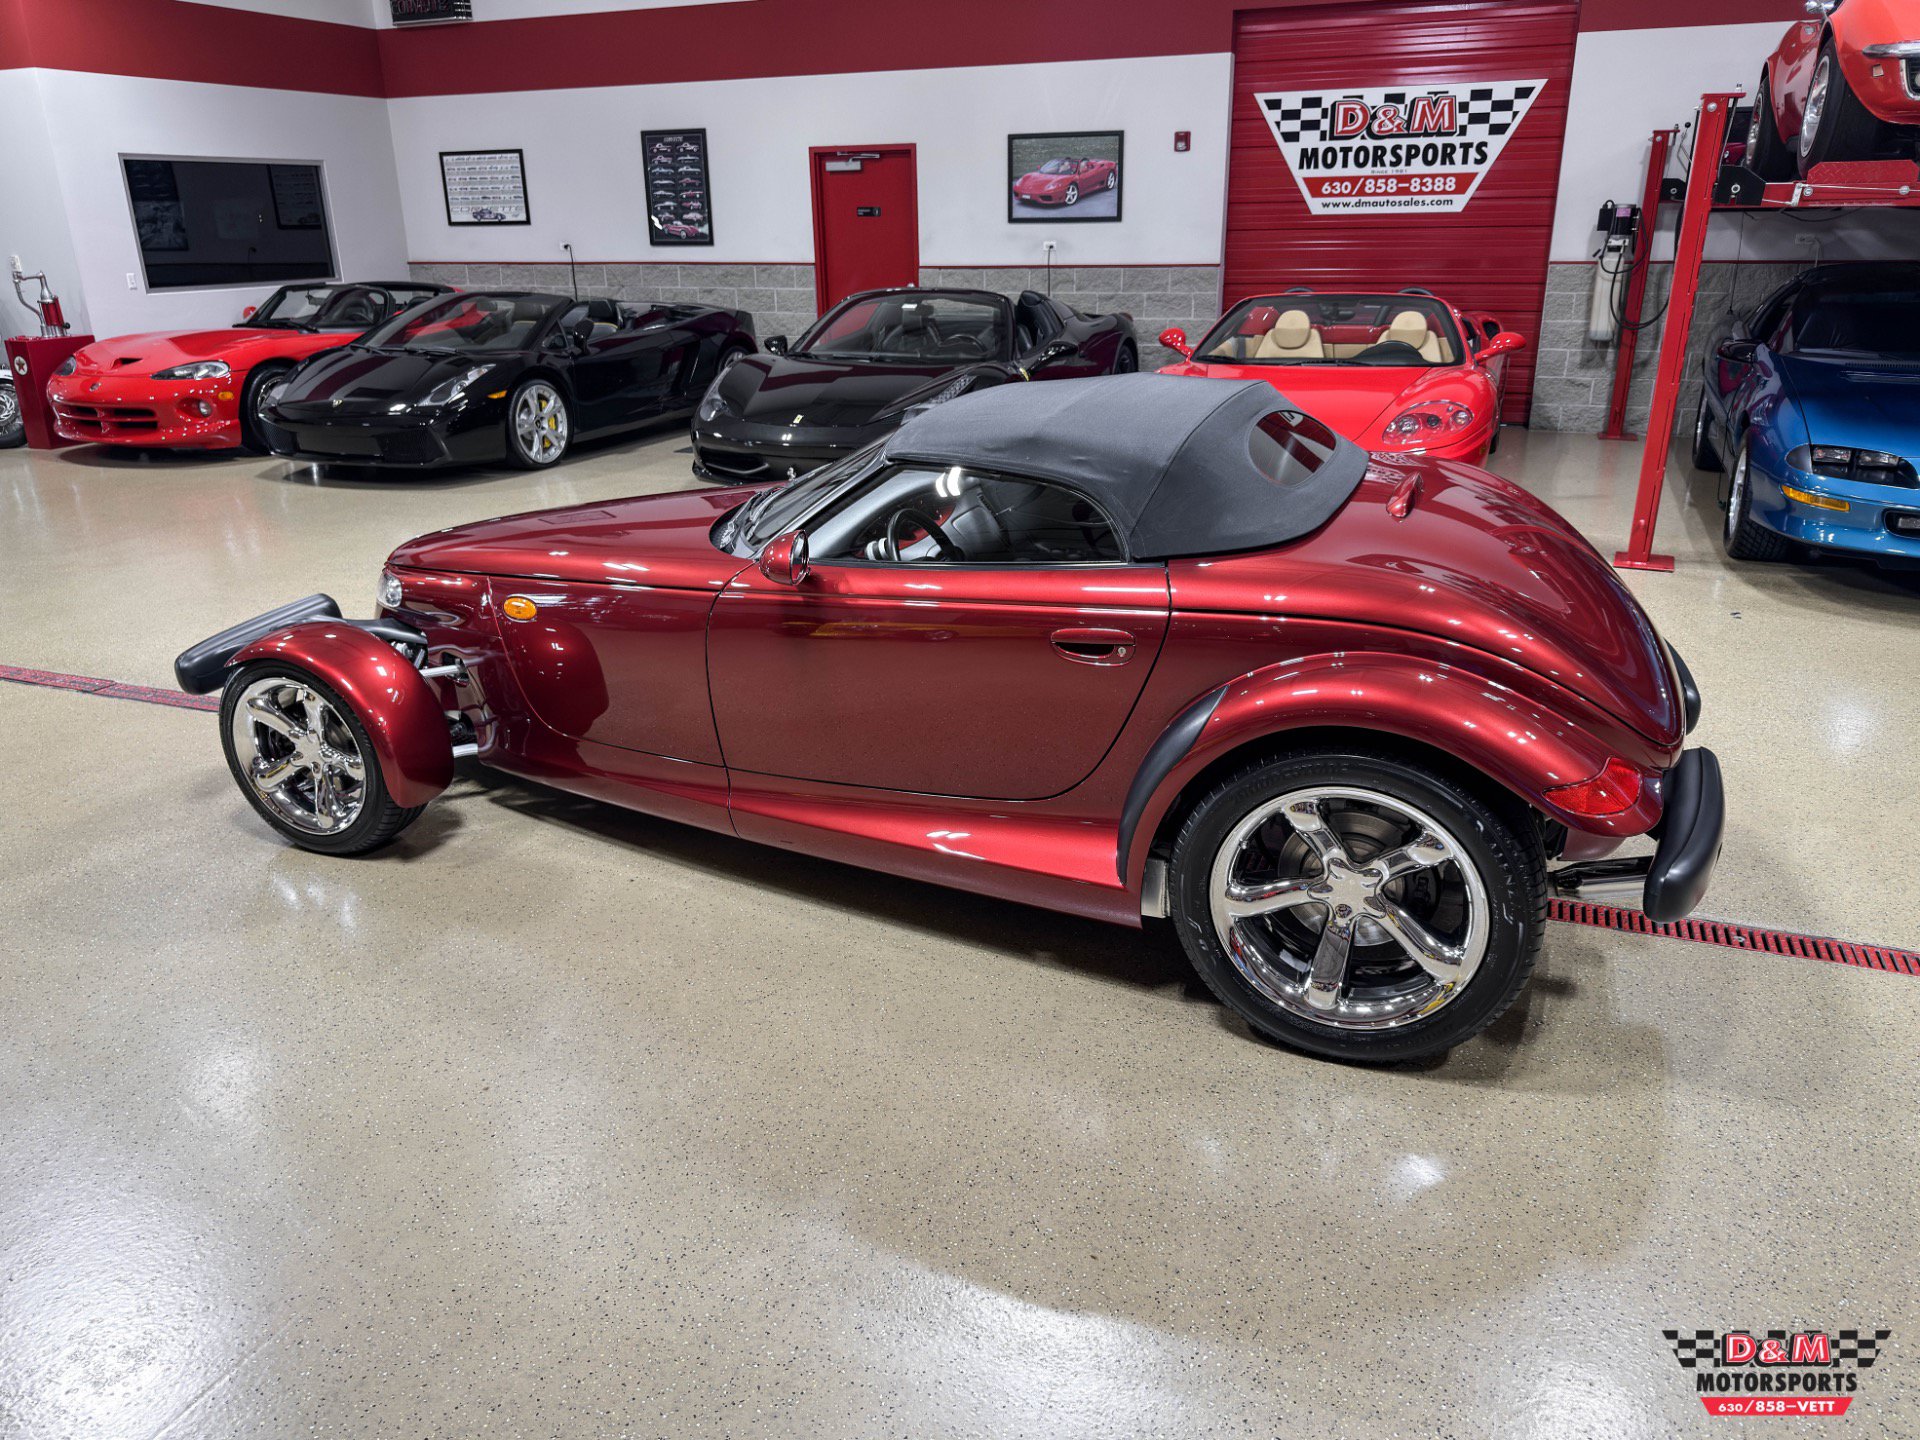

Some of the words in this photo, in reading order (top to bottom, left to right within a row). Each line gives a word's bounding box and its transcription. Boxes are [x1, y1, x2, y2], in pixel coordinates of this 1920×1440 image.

[1331, 96, 1458, 140] D&M
[1298, 141, 1488, 170] MOTORSPORTS
[1321, 177, 1456, 195] 630/858-8388
[1321, 197, 1453, 209] www.dmautosales.com
